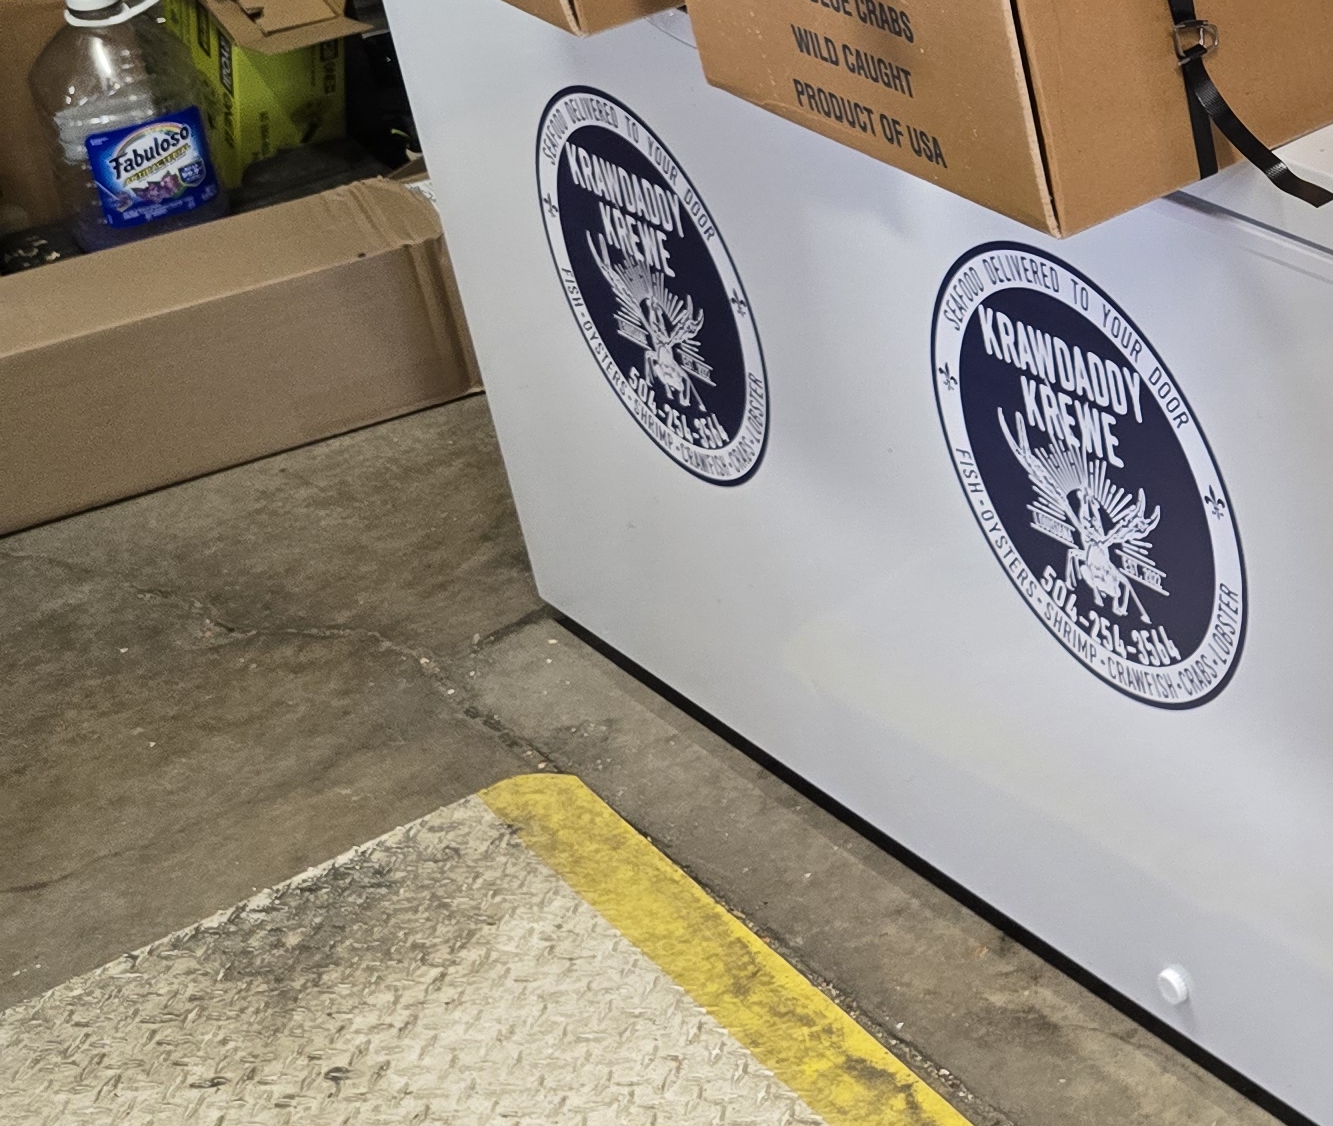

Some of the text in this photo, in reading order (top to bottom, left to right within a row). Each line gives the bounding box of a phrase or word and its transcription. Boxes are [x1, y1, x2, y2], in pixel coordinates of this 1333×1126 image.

[791, 24, 914, 98] WILD CAUGHT
[108, 126, 190, 180] Fabuloso
[542, 97, 716, 241] SEAFOOD DELIVERED TO YOUR DOOR
[793, 78, 948, 169] PRODUCT OF USA
[564, 141, 685, 239] KRAWDADDY
[599, 201, 677, 278] KREWE
[561, 267, 585, 308] FISH
[583, 321, 626, 397] OYSTERS
[634, 399, 674, 450] SHRIMP
[748, 372, 764, 445] LOBSTER
[943, 254, 1190, 429] SEAFOOD DELIVERED TO YOUR DOOR
[978, 304, 1143, 424] KRAWDADDY
[628, 365, 730, 450] 504-254-3564
[1021, 375, 1124, 469] KREWE
[955, 448, 1240, 700] FISH OYSTERS SHRIMP CRAWFISH CRABS LOBSTER
[1039, 565, 1182, 667] 504-254-3564
